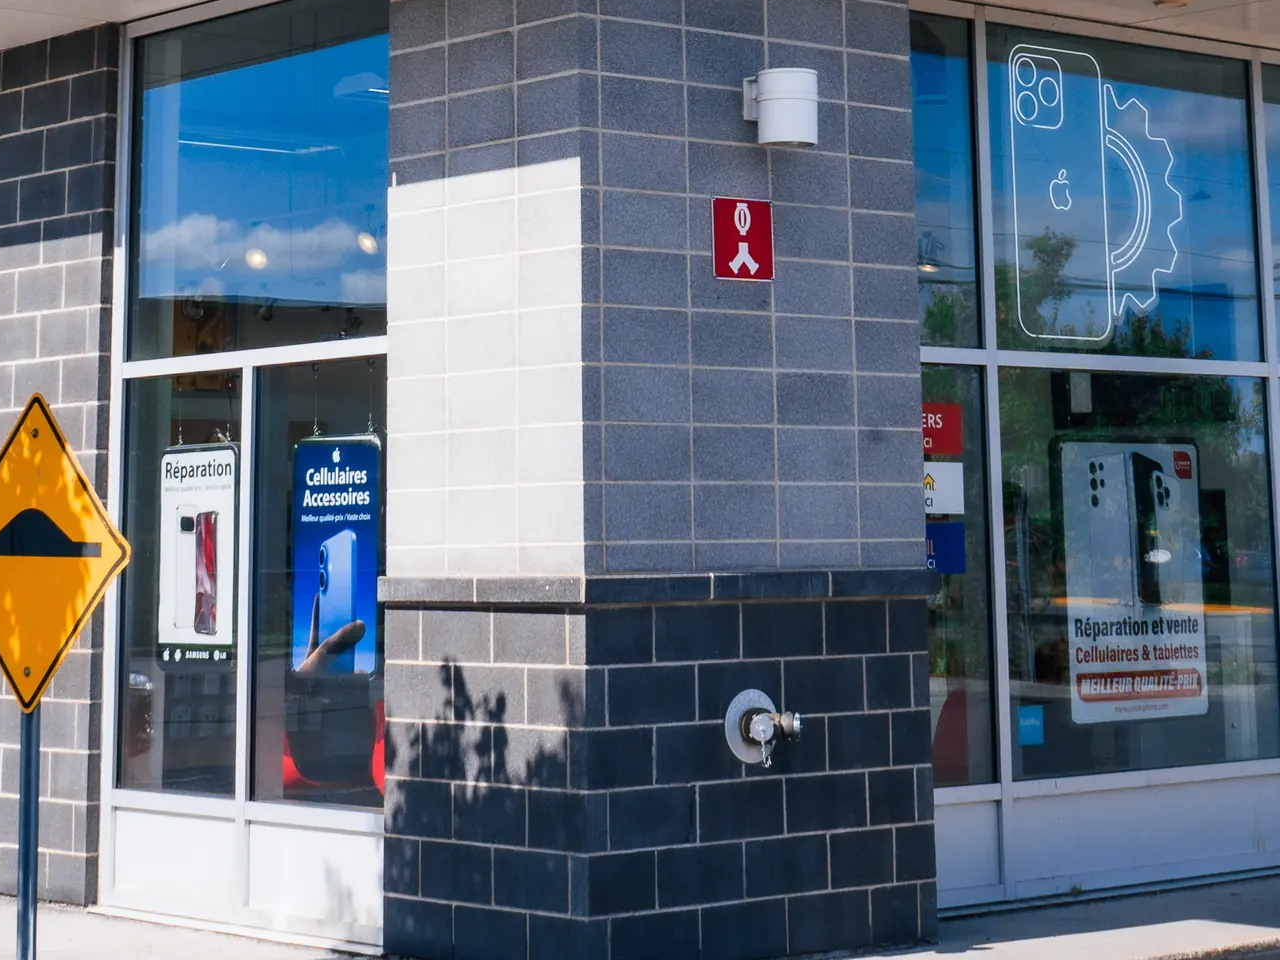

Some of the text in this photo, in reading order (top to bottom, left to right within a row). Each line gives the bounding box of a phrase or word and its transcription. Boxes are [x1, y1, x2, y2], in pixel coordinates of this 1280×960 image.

[922, 413, 943, 428] ERS
[923, 437, 933, 448] CI
[165, 459, 232, 483] Réparation
[306, 467, 368, 486] Cellulaires
[303, 487, 370, 507] Accessoires
[924, 497, 934, 508] CI
[927, 558, 936, 569] CI
[1074, 616, 1199, 642] Réparation et vente
[185, 650, 209, 659] SAMSUNG
[1075, 643, 1199, 664] Cellulaires & tablettes
[1080, 672, 1199, 695] MEILLEUR QUALITÉ-PRIX
